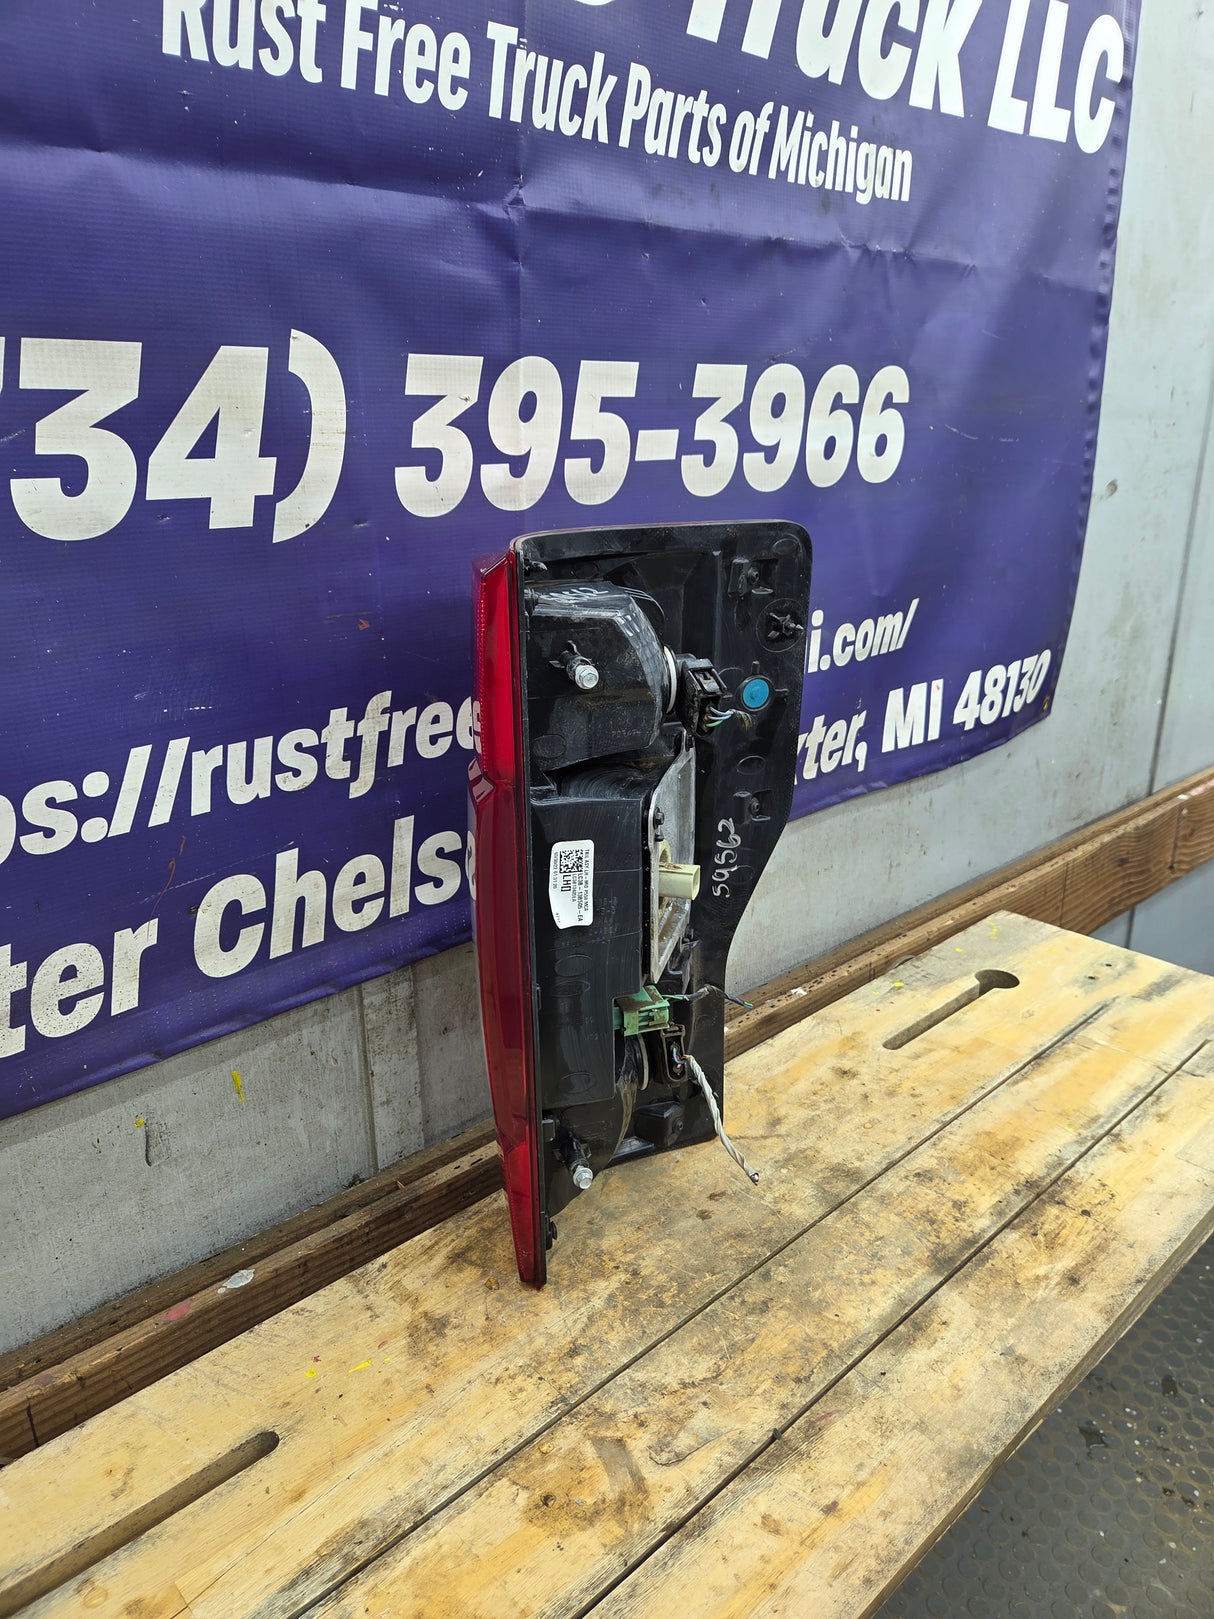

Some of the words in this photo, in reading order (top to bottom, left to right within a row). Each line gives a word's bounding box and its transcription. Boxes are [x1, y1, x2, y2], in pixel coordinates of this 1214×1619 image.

[162, 0, 327, 84] Rust
[340, 0, 472, 111] Free
[487, 20, 619, 144] Truck
[618, 61, 722, 168] Parts
[729, 101, 773, 176] of
[768, 110, 913, 205] Michigan
[987, 0, 1125, 154] LLC
[0, 328, 346, 544] 34)
[394, 352, 910, 518] 395-3966
[803, 598, 920, 674] i.com/
[193, 815, 470, 979] Chels
[881, 678, 944, 753] MI
[952, 649, 1052, 731] 48130
[711, 817, 742, 898] 59562
